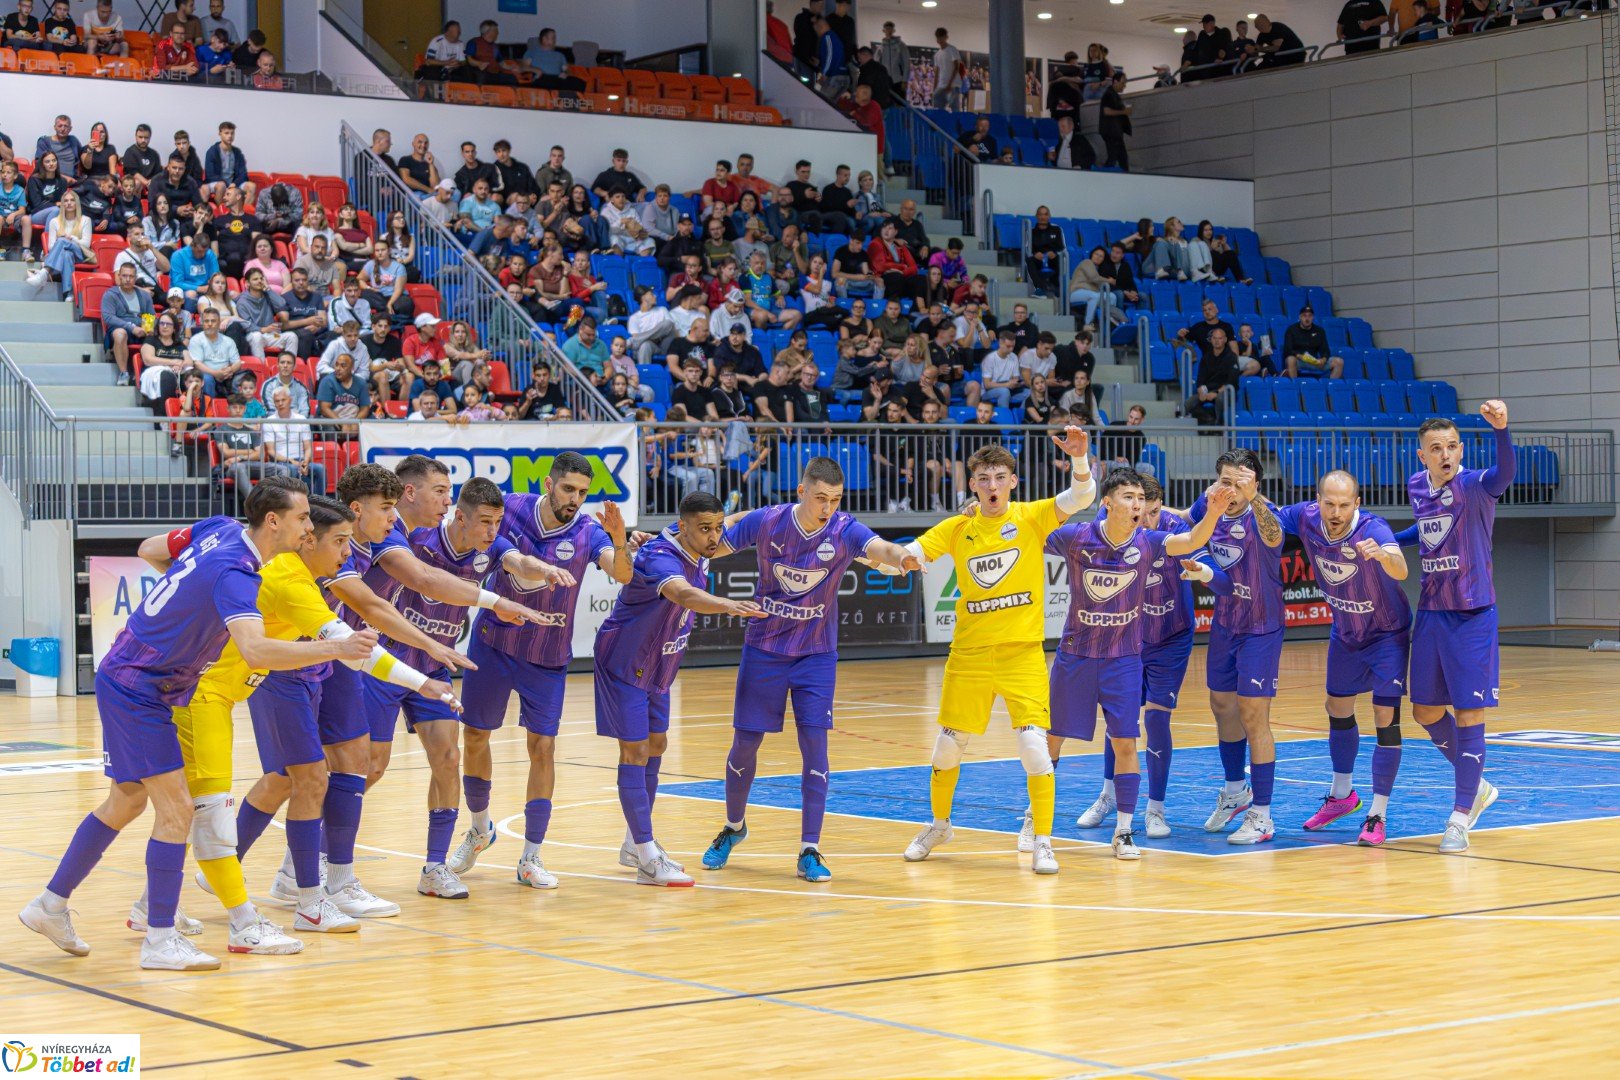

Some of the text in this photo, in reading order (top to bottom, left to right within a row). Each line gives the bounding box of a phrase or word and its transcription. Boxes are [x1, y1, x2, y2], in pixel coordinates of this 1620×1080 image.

[1424, 521, 1442, 535] MOL
[976, 556, 1004, 574] MOL
[782, 568, 809, 585] MOL
[1091, 574, 1119, 588] MOL
[877, 611, 908, 625] KFT
